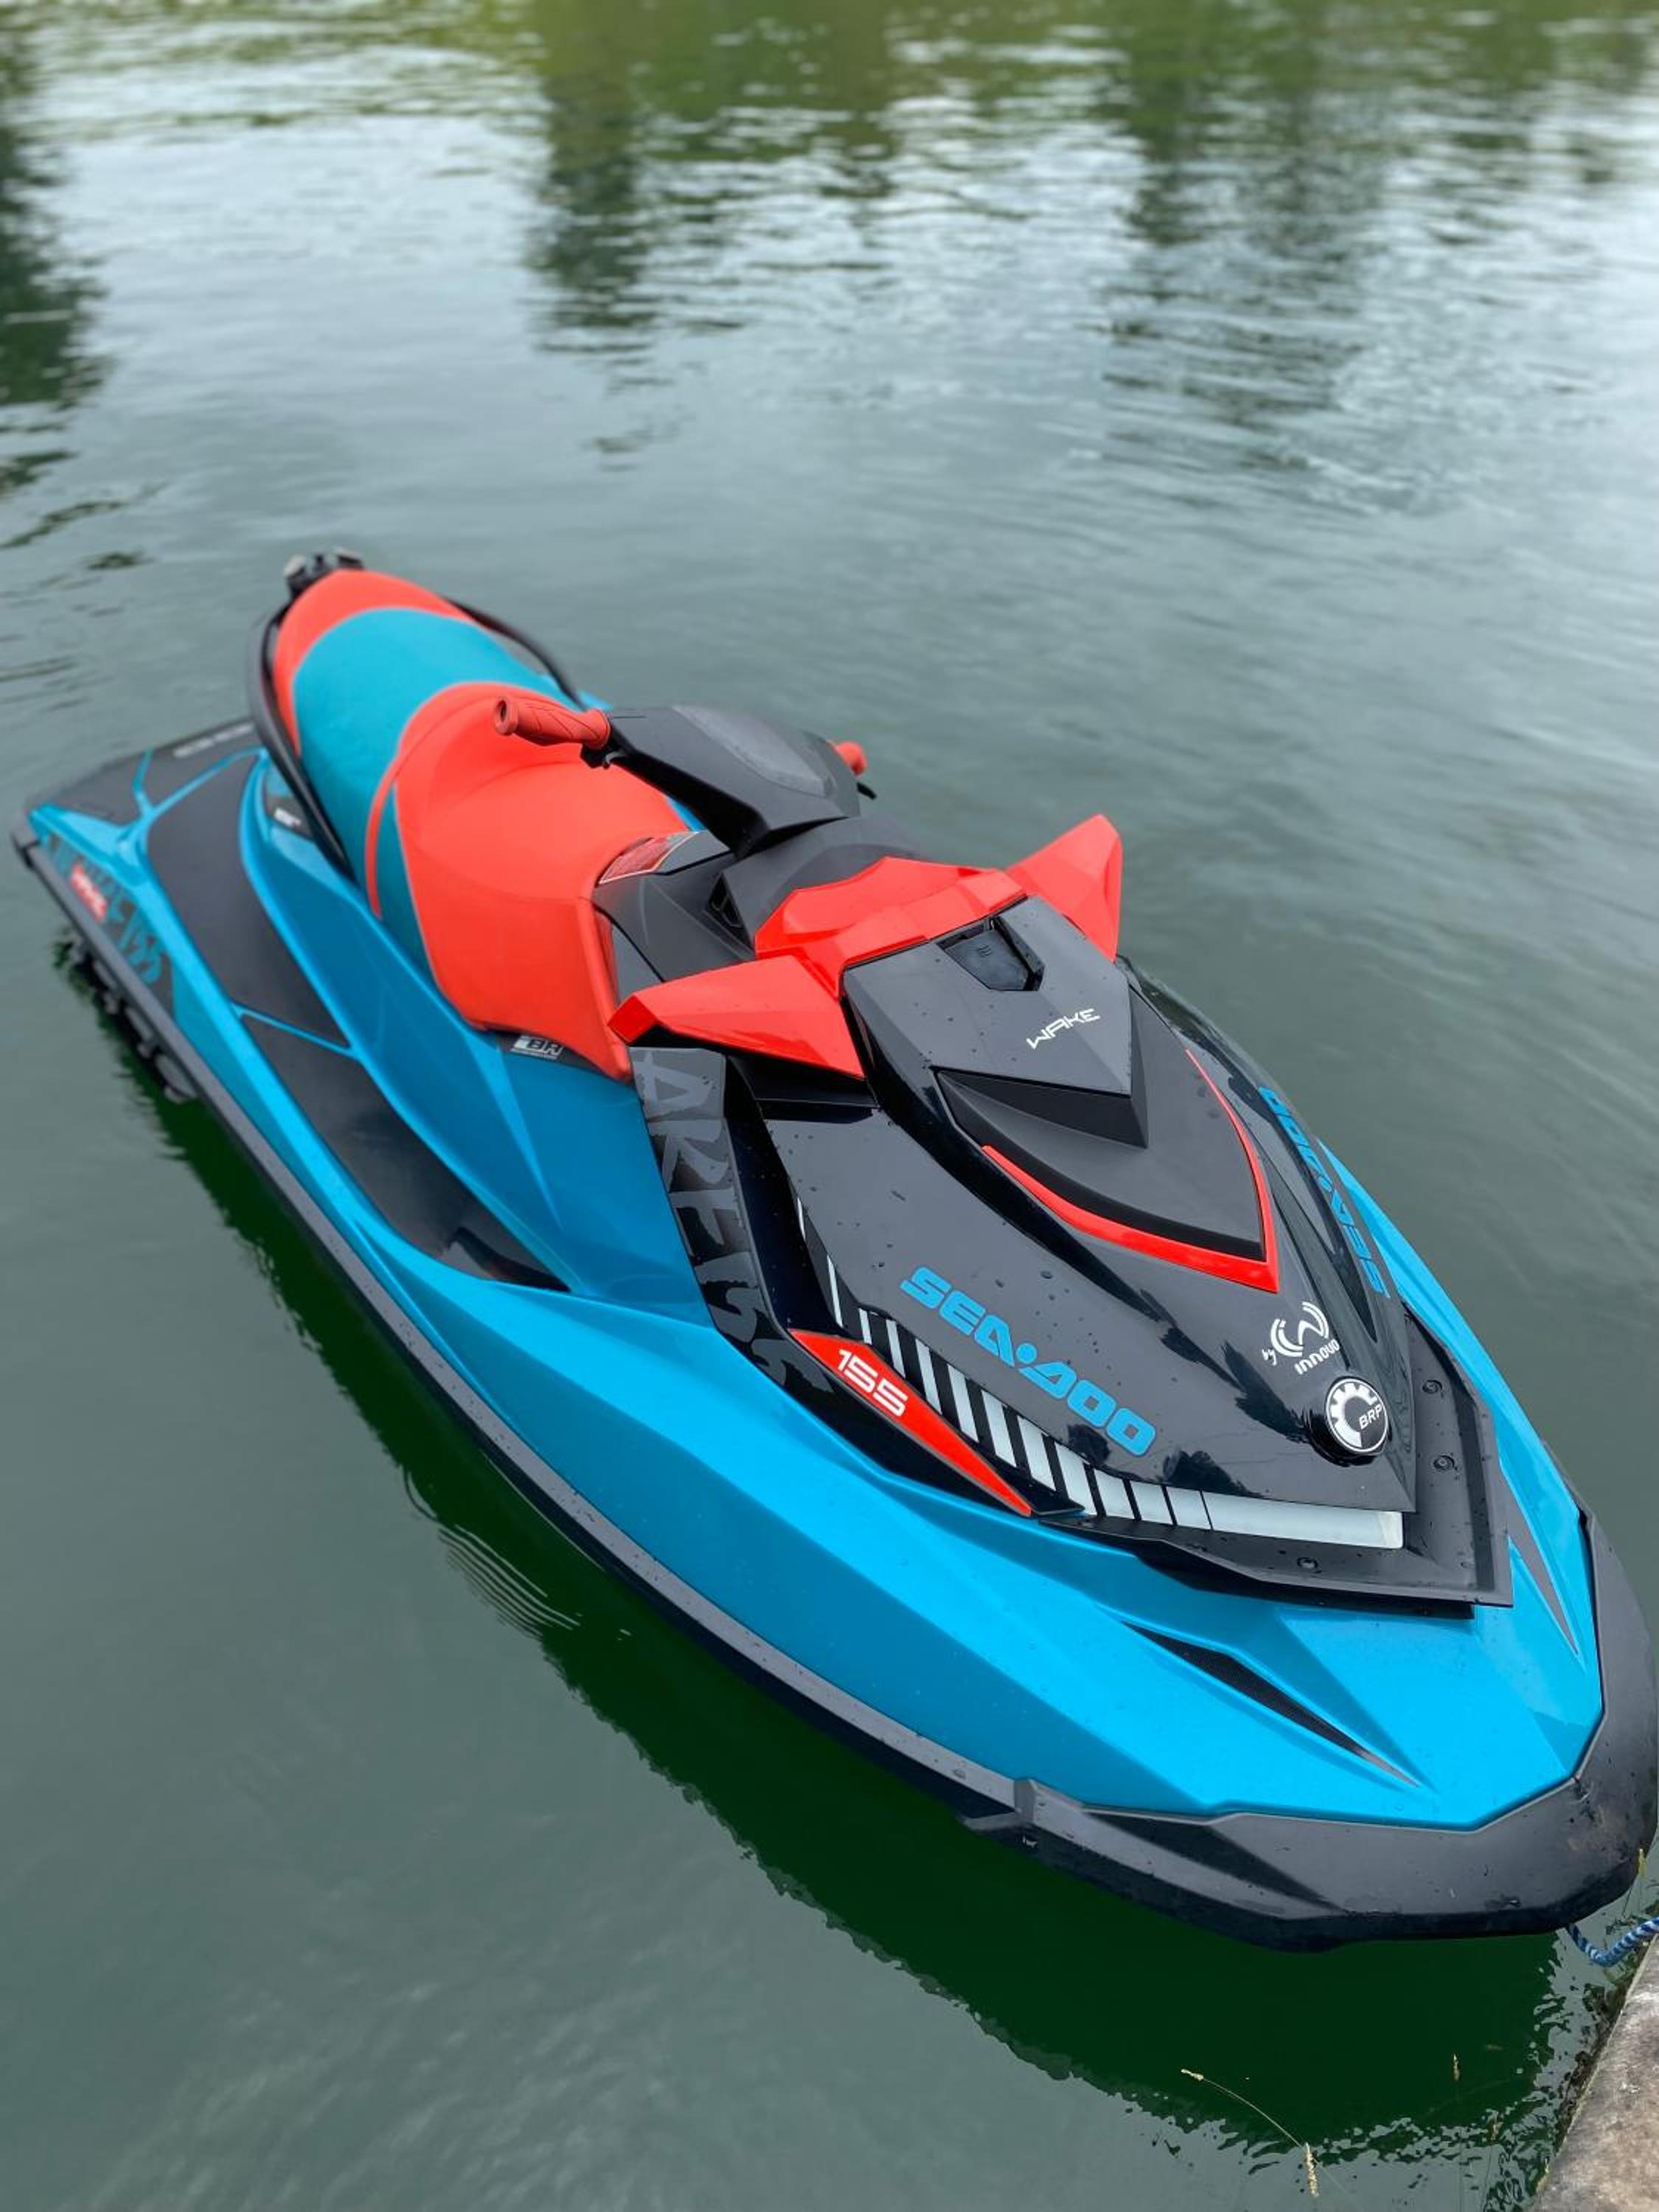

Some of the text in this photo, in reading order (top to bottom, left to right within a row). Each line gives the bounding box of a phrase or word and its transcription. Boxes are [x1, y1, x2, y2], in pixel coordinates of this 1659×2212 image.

[1026, 1008, 1101, 1050] WAKE
[838, 1349, 908, 1416] 155
[1359, 1404, 1382, 1430] BRP
